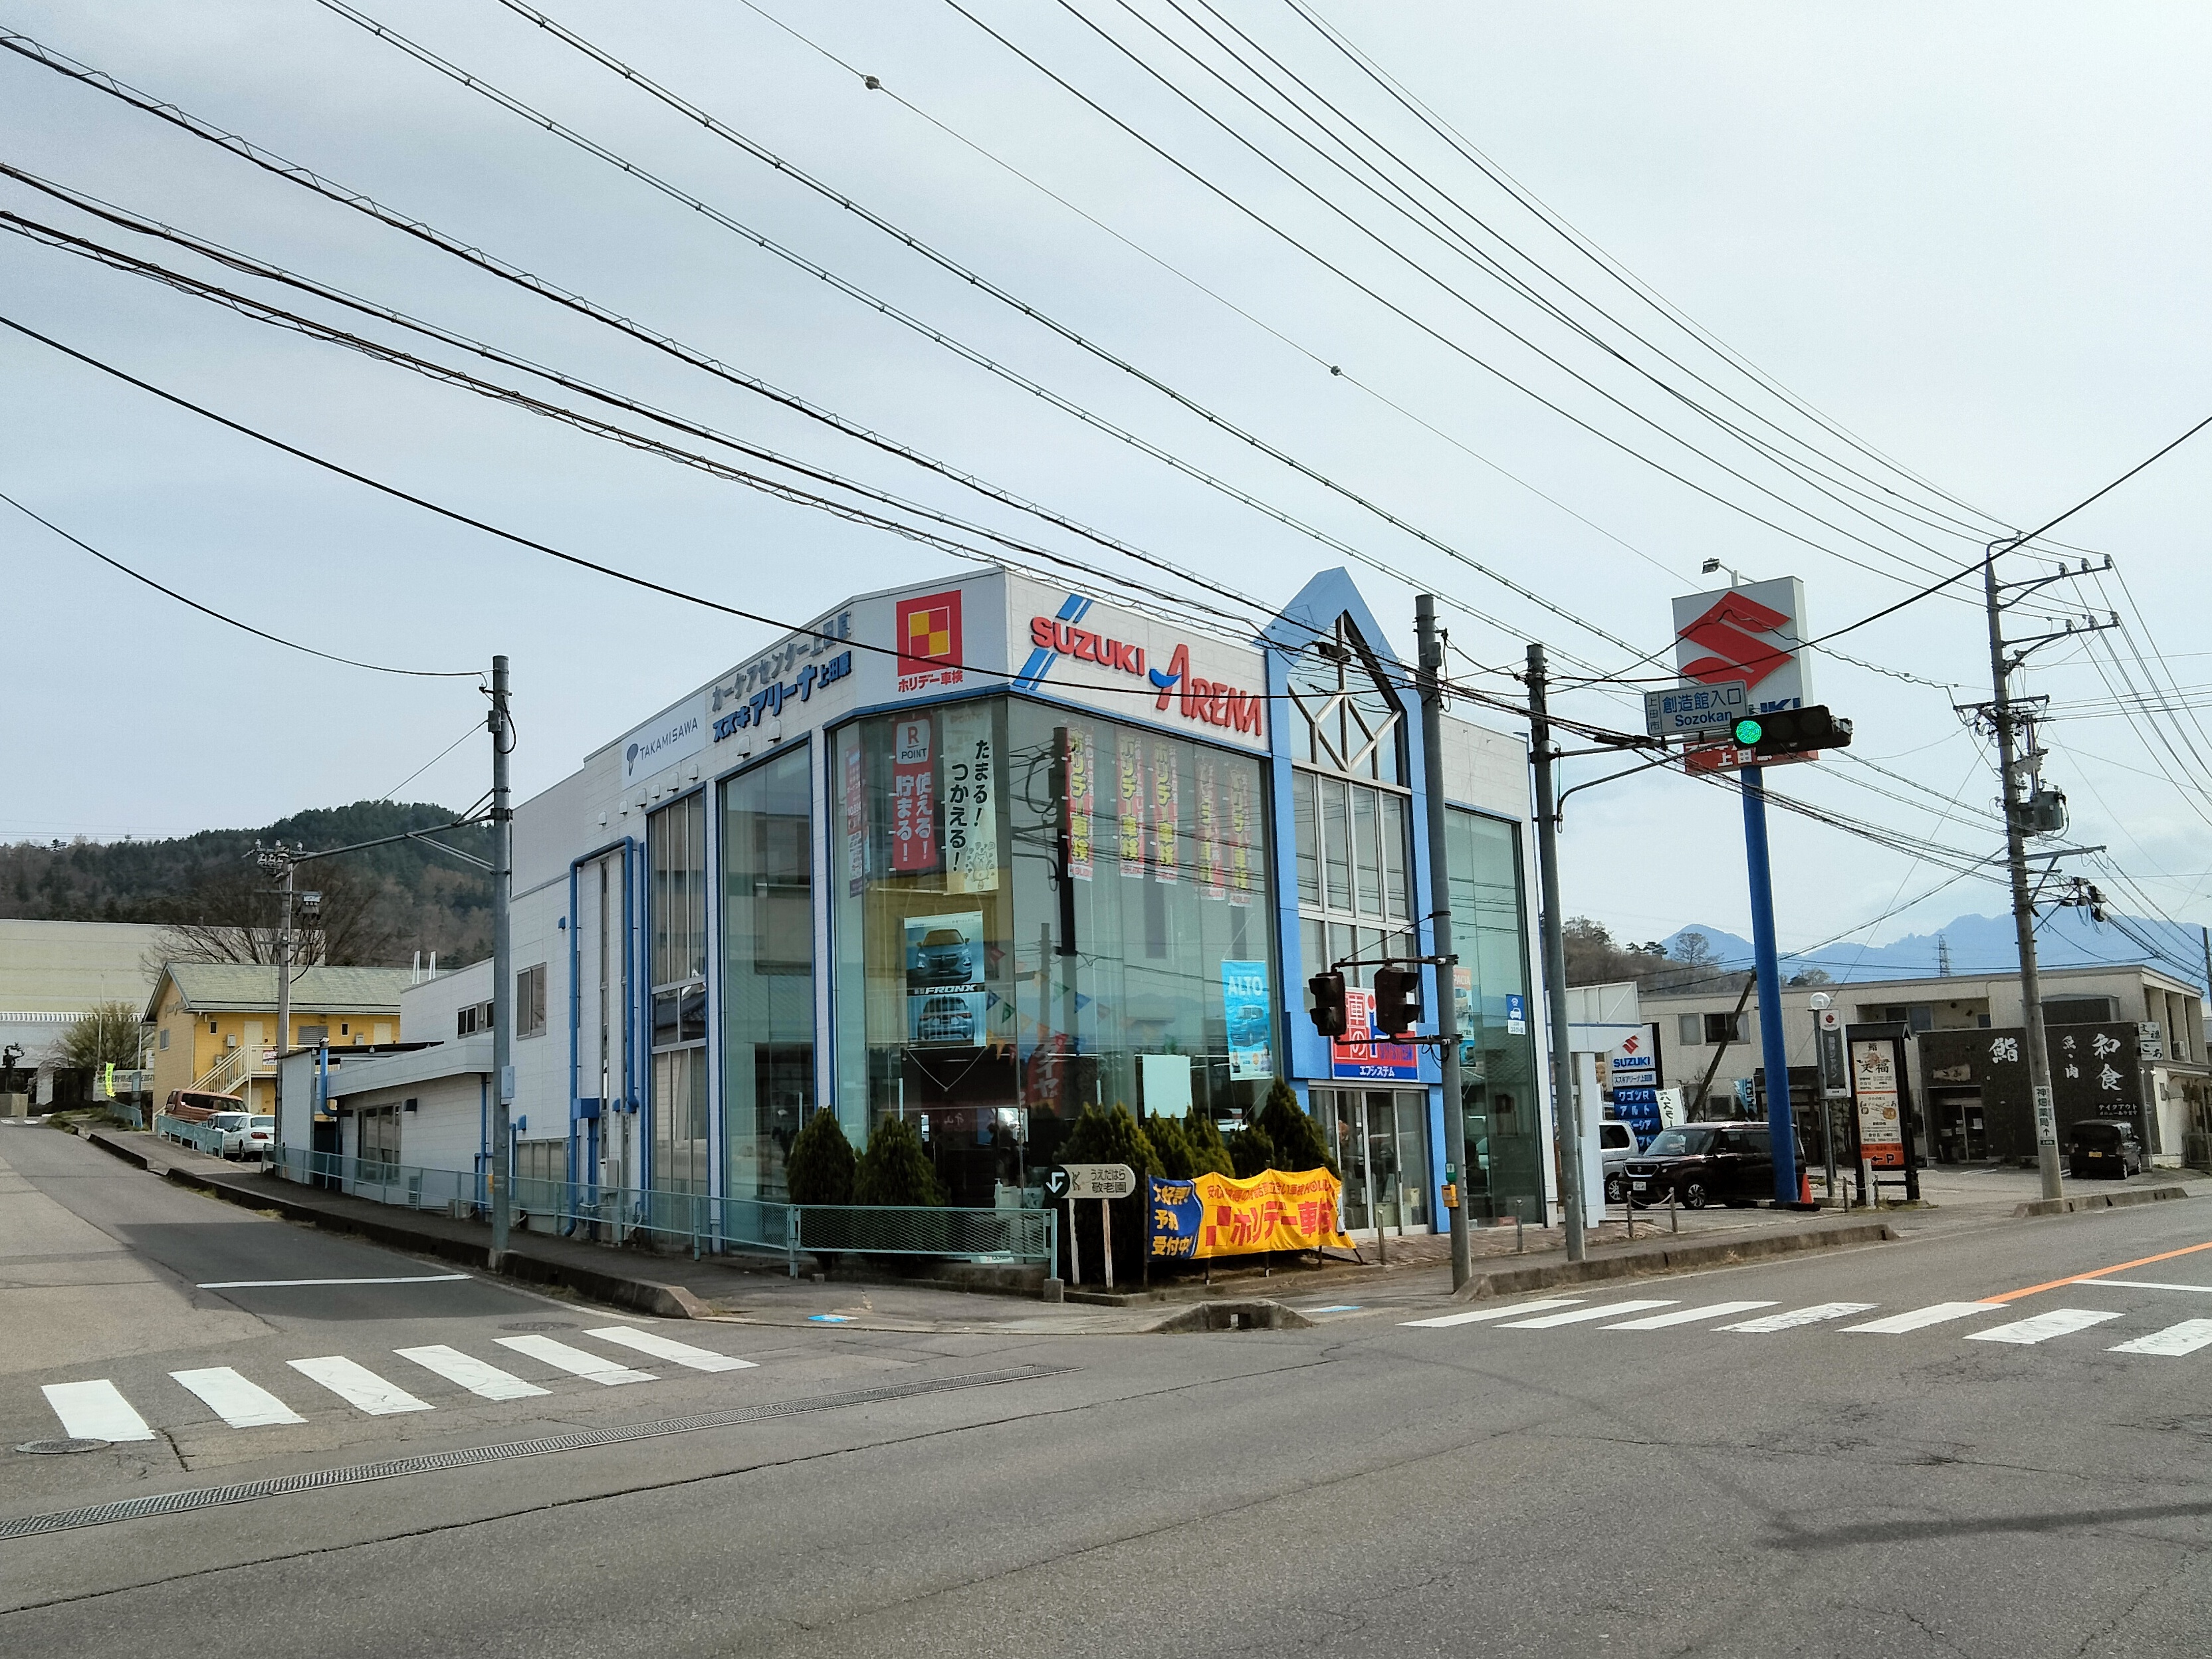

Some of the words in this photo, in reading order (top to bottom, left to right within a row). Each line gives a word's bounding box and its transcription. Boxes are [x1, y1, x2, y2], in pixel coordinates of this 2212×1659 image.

[898, 669, 963, 693] ホリデー車検
[1030, 616, 1145, 677] SUZUKI
[1155, 643, 1262, 736] ARENA
[1662, 688, 1741, 714] 創造館入口
[1648, 698, 1660, 730] 上田市
[1675, 711, 1733, 728] Sozokan
[639, 717, 699, 760] TAKAMISAWA
[901, 748, 927, 759] POINT
[973, 740, 990, 827] たまる!
[895, 775, 914, 861] 貯まる!
[916, 772, 932, 859] 使える!
[949, 764, 969, 871] つかえる!
[925, 984, 977, 995] FRONX
[1227, 975, 1264, 996] ALTO
[1454, 974, 1471, 986] PACIA
[1989, 1037, 2018, 1063] 鮨
[1359, 1065, 1395, 1077] エフシステム
[1613, 1056, 1650, 1067] SUZUKI
[2092, 1033, 2124, 1091] 和食
[1618, 1090, 1650, 1102] ワゴンR
[1620, 1105, 1650, 1116] アルト
[1886, 1154, 1894, 1164] P
[1090, 1168, 1126, 1181] うえだはら
[1091, 1182, 1127, 1194] 敬老園
